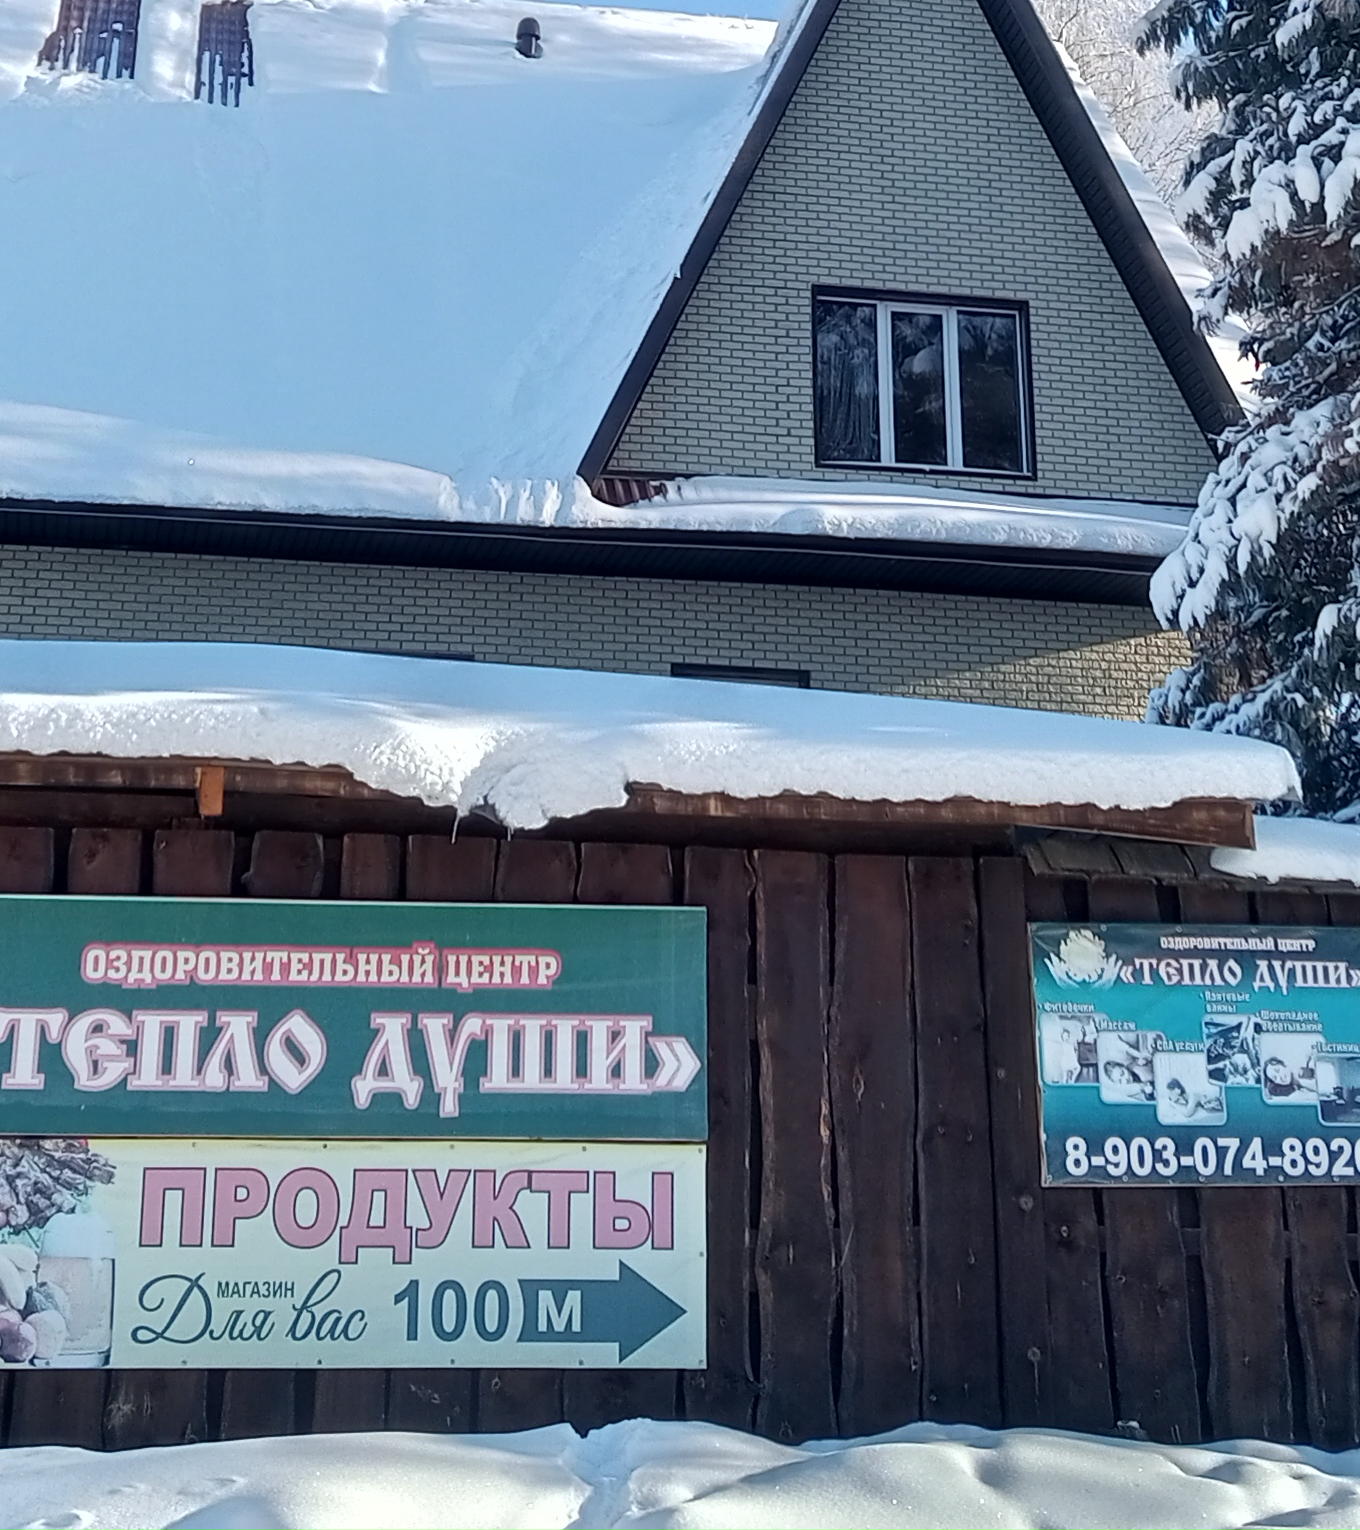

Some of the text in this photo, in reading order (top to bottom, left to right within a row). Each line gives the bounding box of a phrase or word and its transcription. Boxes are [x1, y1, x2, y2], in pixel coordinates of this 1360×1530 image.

[83, 944, 560, 992] ОЗДОРОВИТЕЛЬНЫЙ ЦЕНТР
[1160, 936, 1316, 954] ОЗДОРОВИТЕЛЬНЫЙ ЦЕНТР
[351, 1011, 703, 1118] ДУШИ»
[138, 1167, 675, 1266] ПРОДУКТЫ
[130, 1269, 368, 1345] Для вас
[216, 1280, 295, 1301] МАГАЗИН
[393, 1279, 510, 1342] 100
